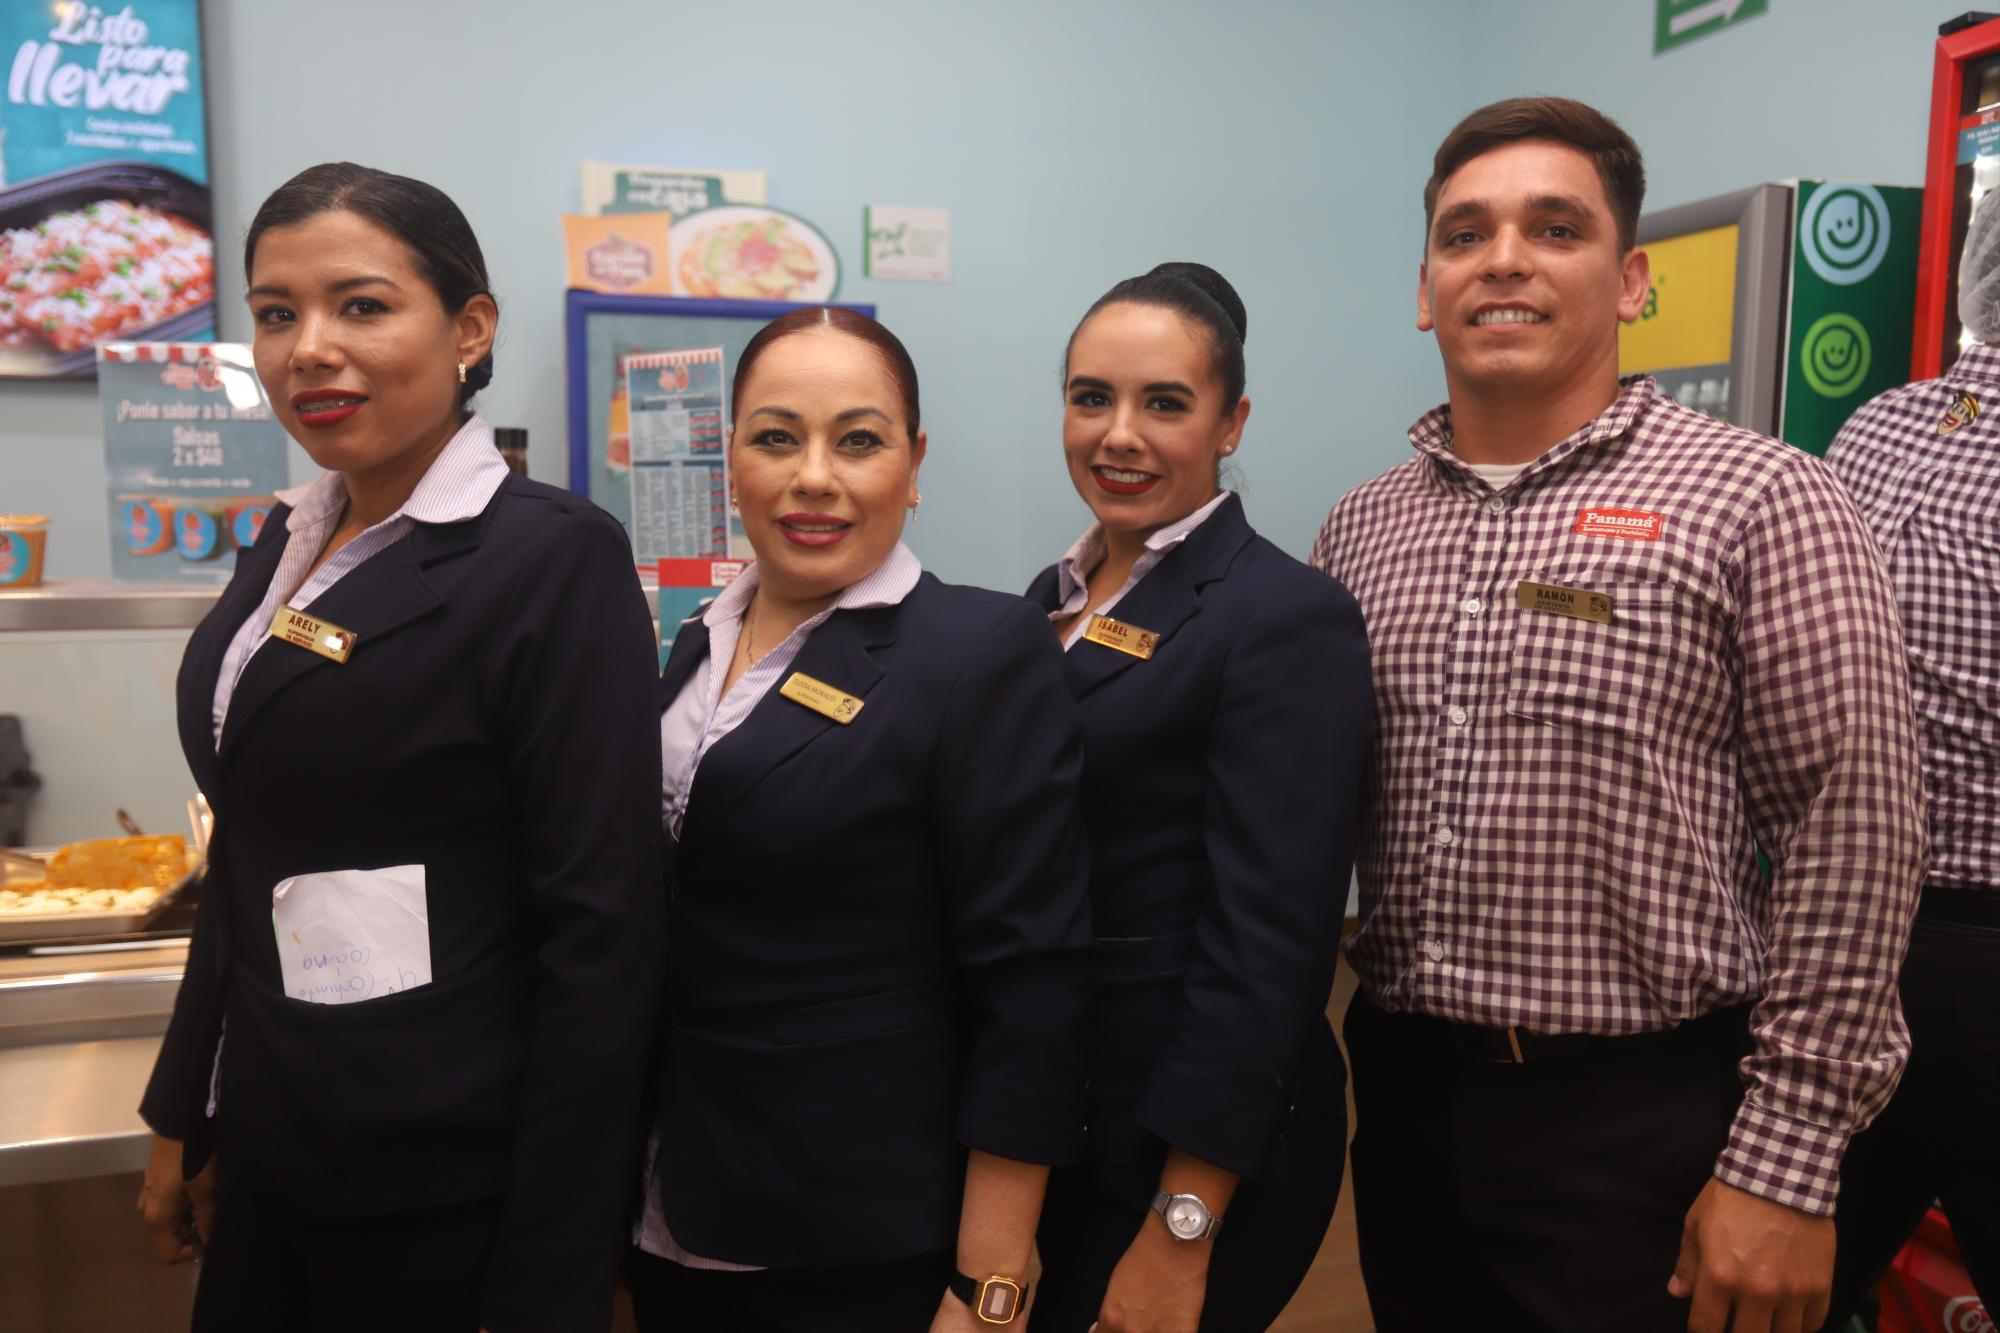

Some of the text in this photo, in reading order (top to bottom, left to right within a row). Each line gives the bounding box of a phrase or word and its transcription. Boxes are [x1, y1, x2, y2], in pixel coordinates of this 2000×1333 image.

[50, 1, 148, 45] Listo
[98, 44, 189, 77] para
[8, 40, 188, 115] llevar
[162, 401, 199, 420] sabor
[203, 405, 213, 420] a
[214, 403, 229, 420] tu
[173, 426, 220, 446] Salsas
[173, 447, 183, 466] 2
[185, 452, 195, 466] x
[1584, 512, 1654, 528] Panamá
[1536, 589, 1575, 604] RAMÓN
[288, 614, 321, 634] ARELY
[1098, 619, 1128, 637] ISABEL
